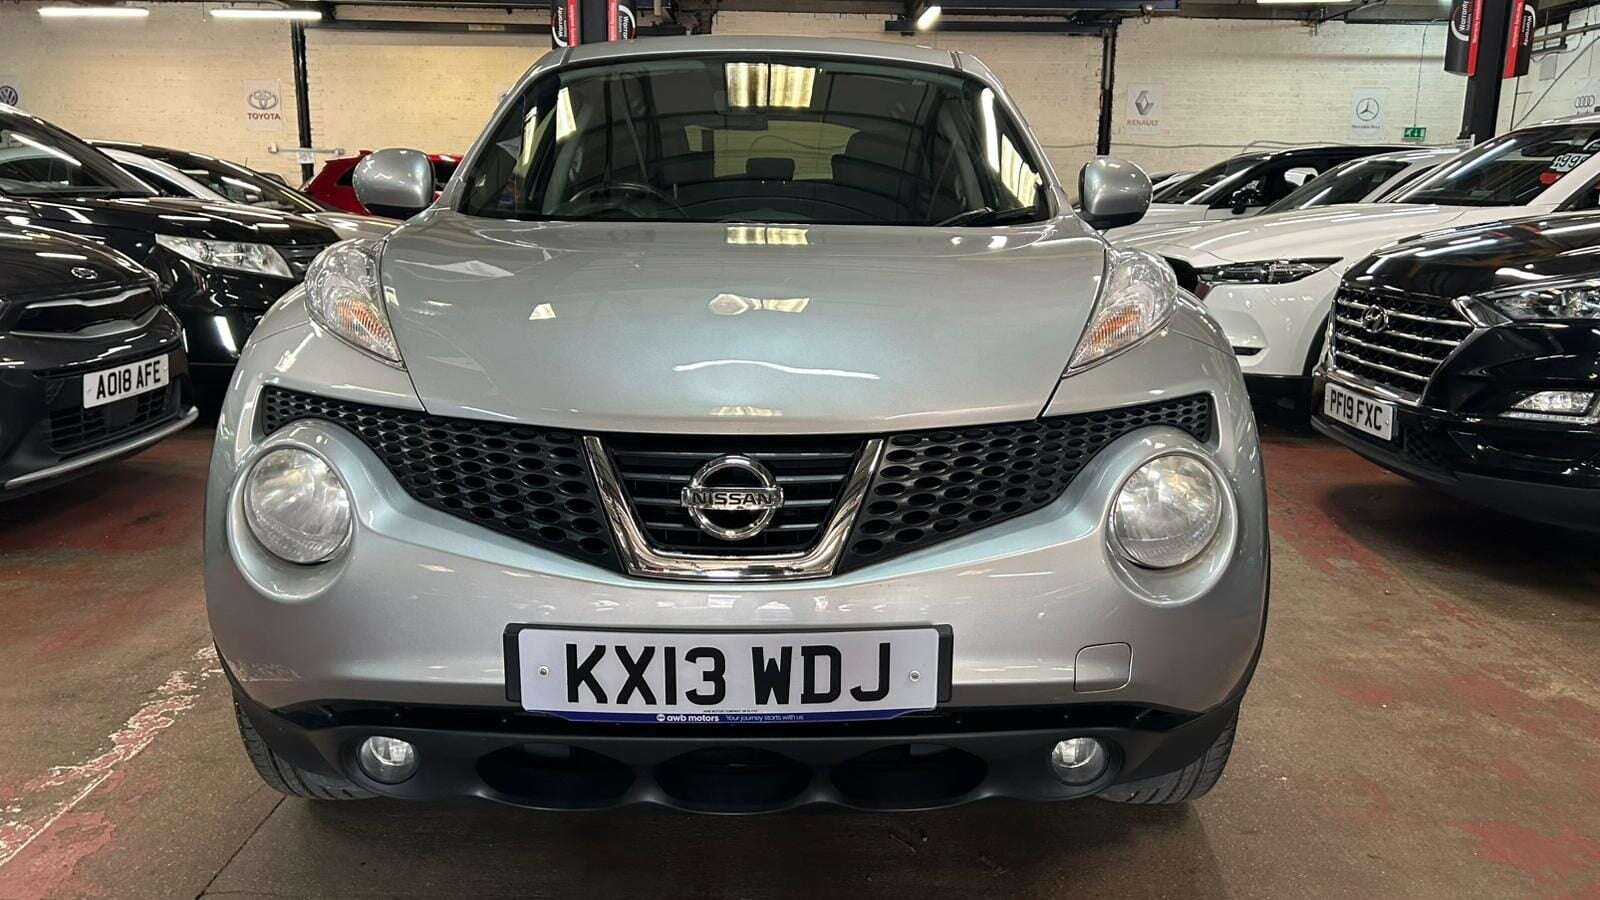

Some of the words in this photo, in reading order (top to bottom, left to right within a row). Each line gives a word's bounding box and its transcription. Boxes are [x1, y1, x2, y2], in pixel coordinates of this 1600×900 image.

[247, 112, 281, 121] TOYOTA
[136, 359, 161, 389] AFE
[1330, 389, 1354, 420] PF19
[1356, 399, 1383, 431] FXC
[692, 492, 772, 506] NISSAN
[565, 643, 726, 705] KX13
[751, 642, 891, 705] WDJ
[666, 714, 687, 722] awb
[688, 714, 720, 722] motors
